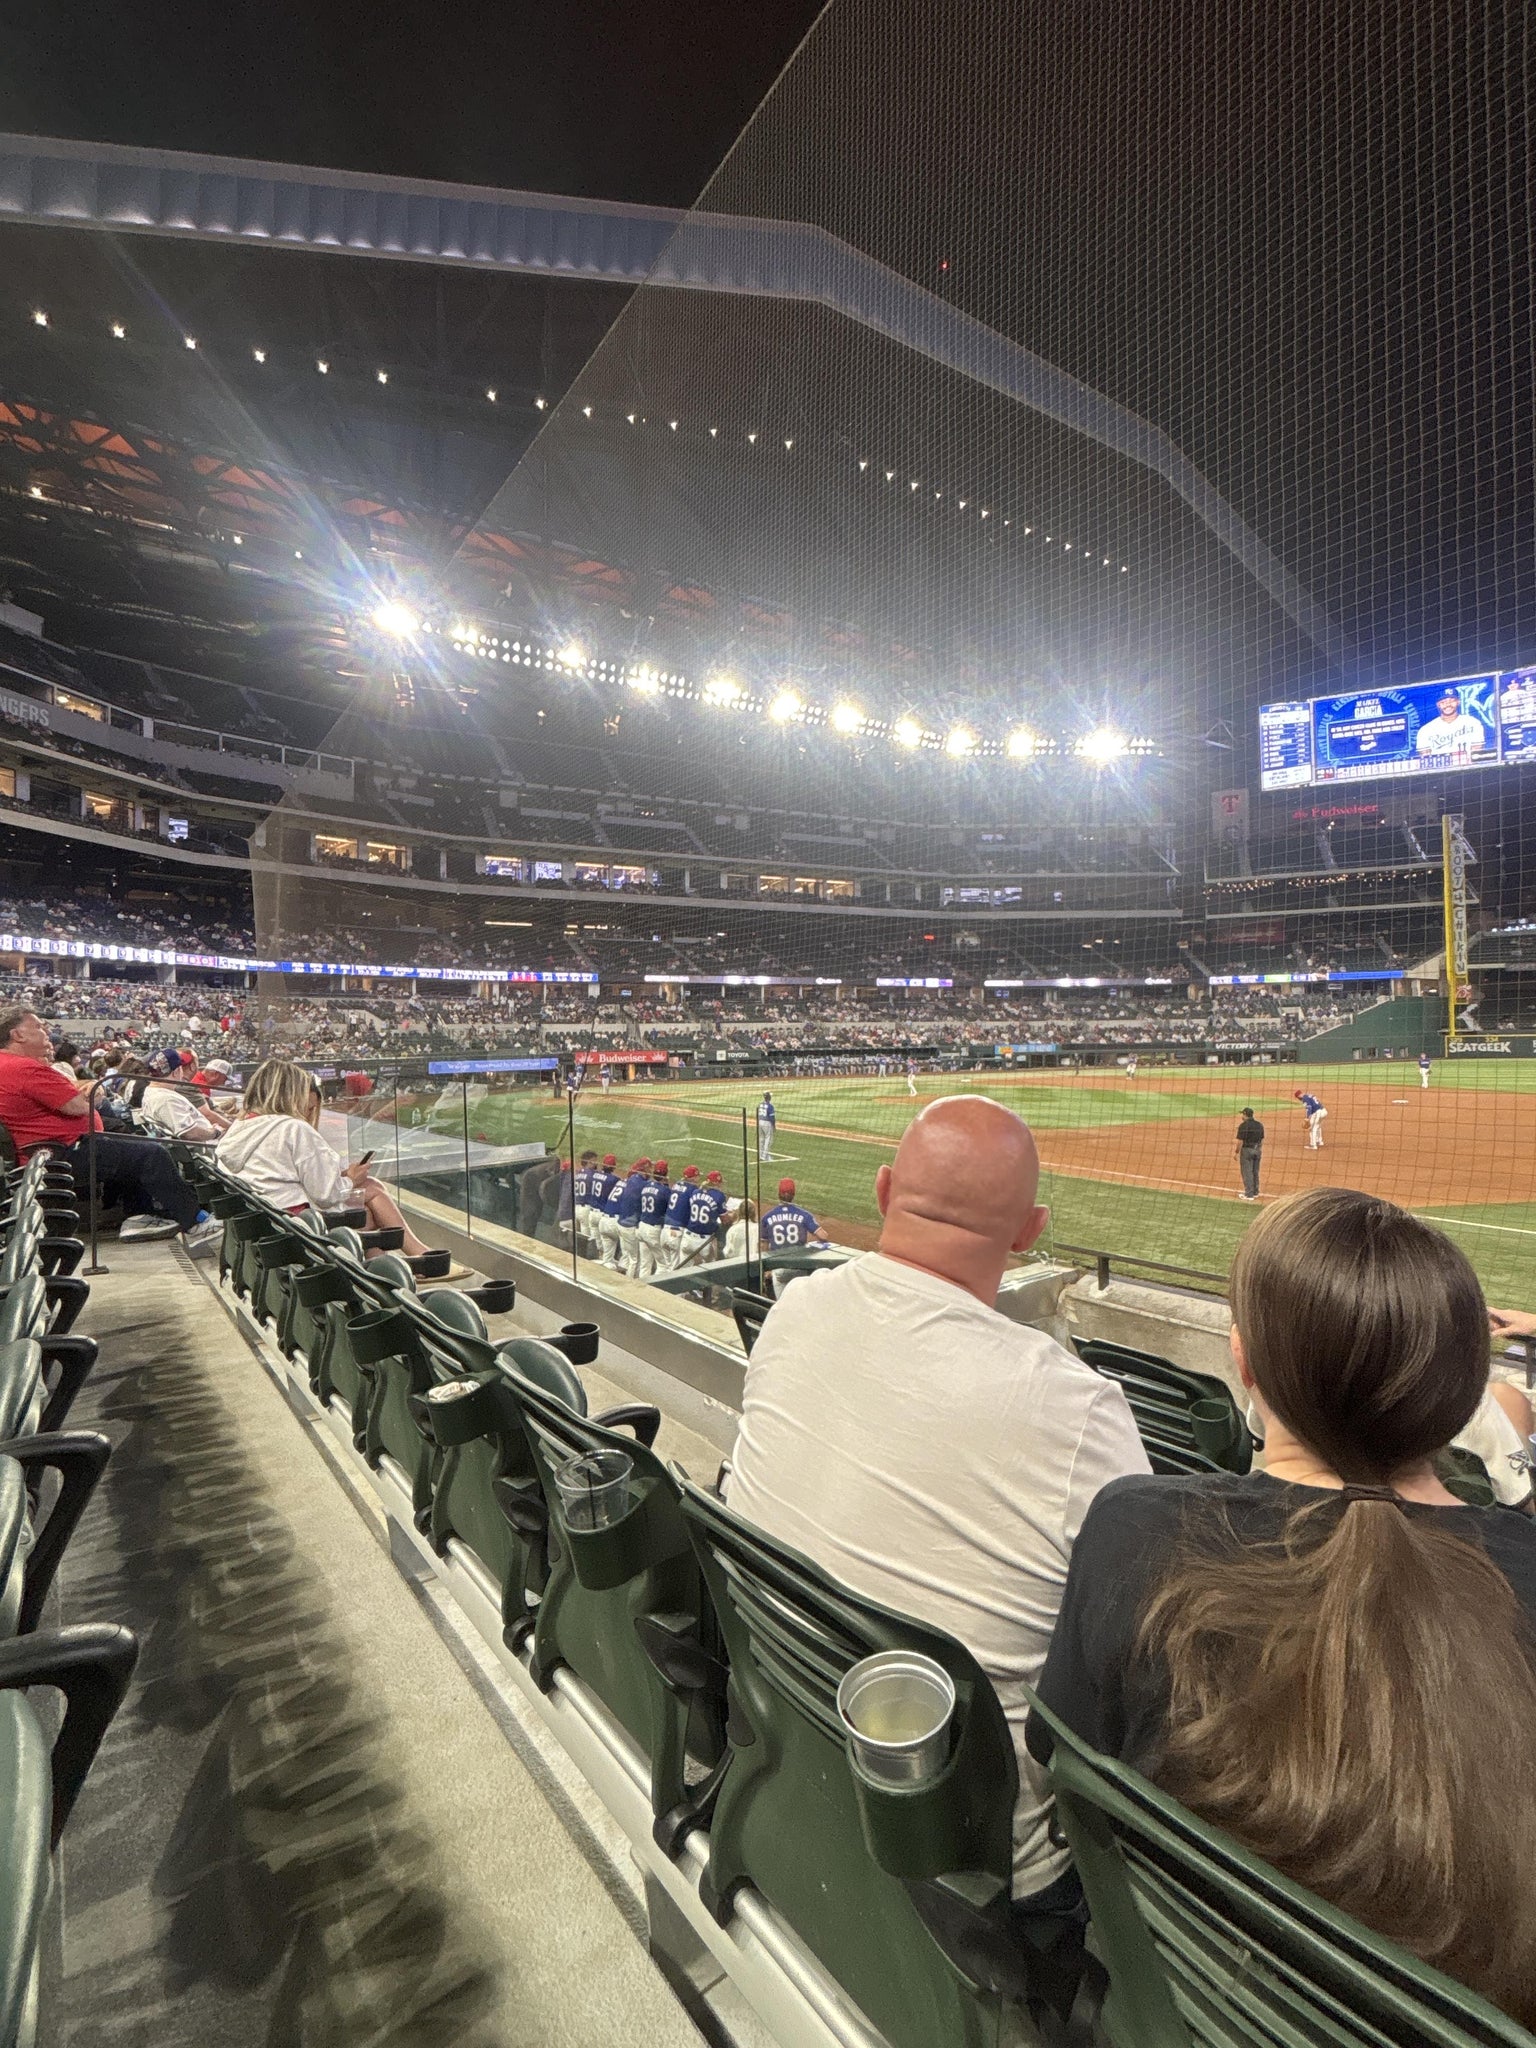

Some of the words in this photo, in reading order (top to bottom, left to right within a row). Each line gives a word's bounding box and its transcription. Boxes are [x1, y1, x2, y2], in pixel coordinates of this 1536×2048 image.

[1355, 705, 1383, 719] GARCIA
[1428, 725, 1474, 750] Royals
[1311, 804, 1379, 818] Budweiser
[1216, 1042, 1255, 1050] VICTORY
[1448, 1041, 1512, 1053] SEATGEEK
[599, 1053, 647, 1063] Budweiser
[591, 1181, 602, 1197] 19
[608, 1186, 624, 1202] 12
[641, 1196, 655, 1213] 83
[668, 1193, 679, 1210] 9
[690, 1204, 710, 1224] 96
[772, 1223, 799, 1245] 68
